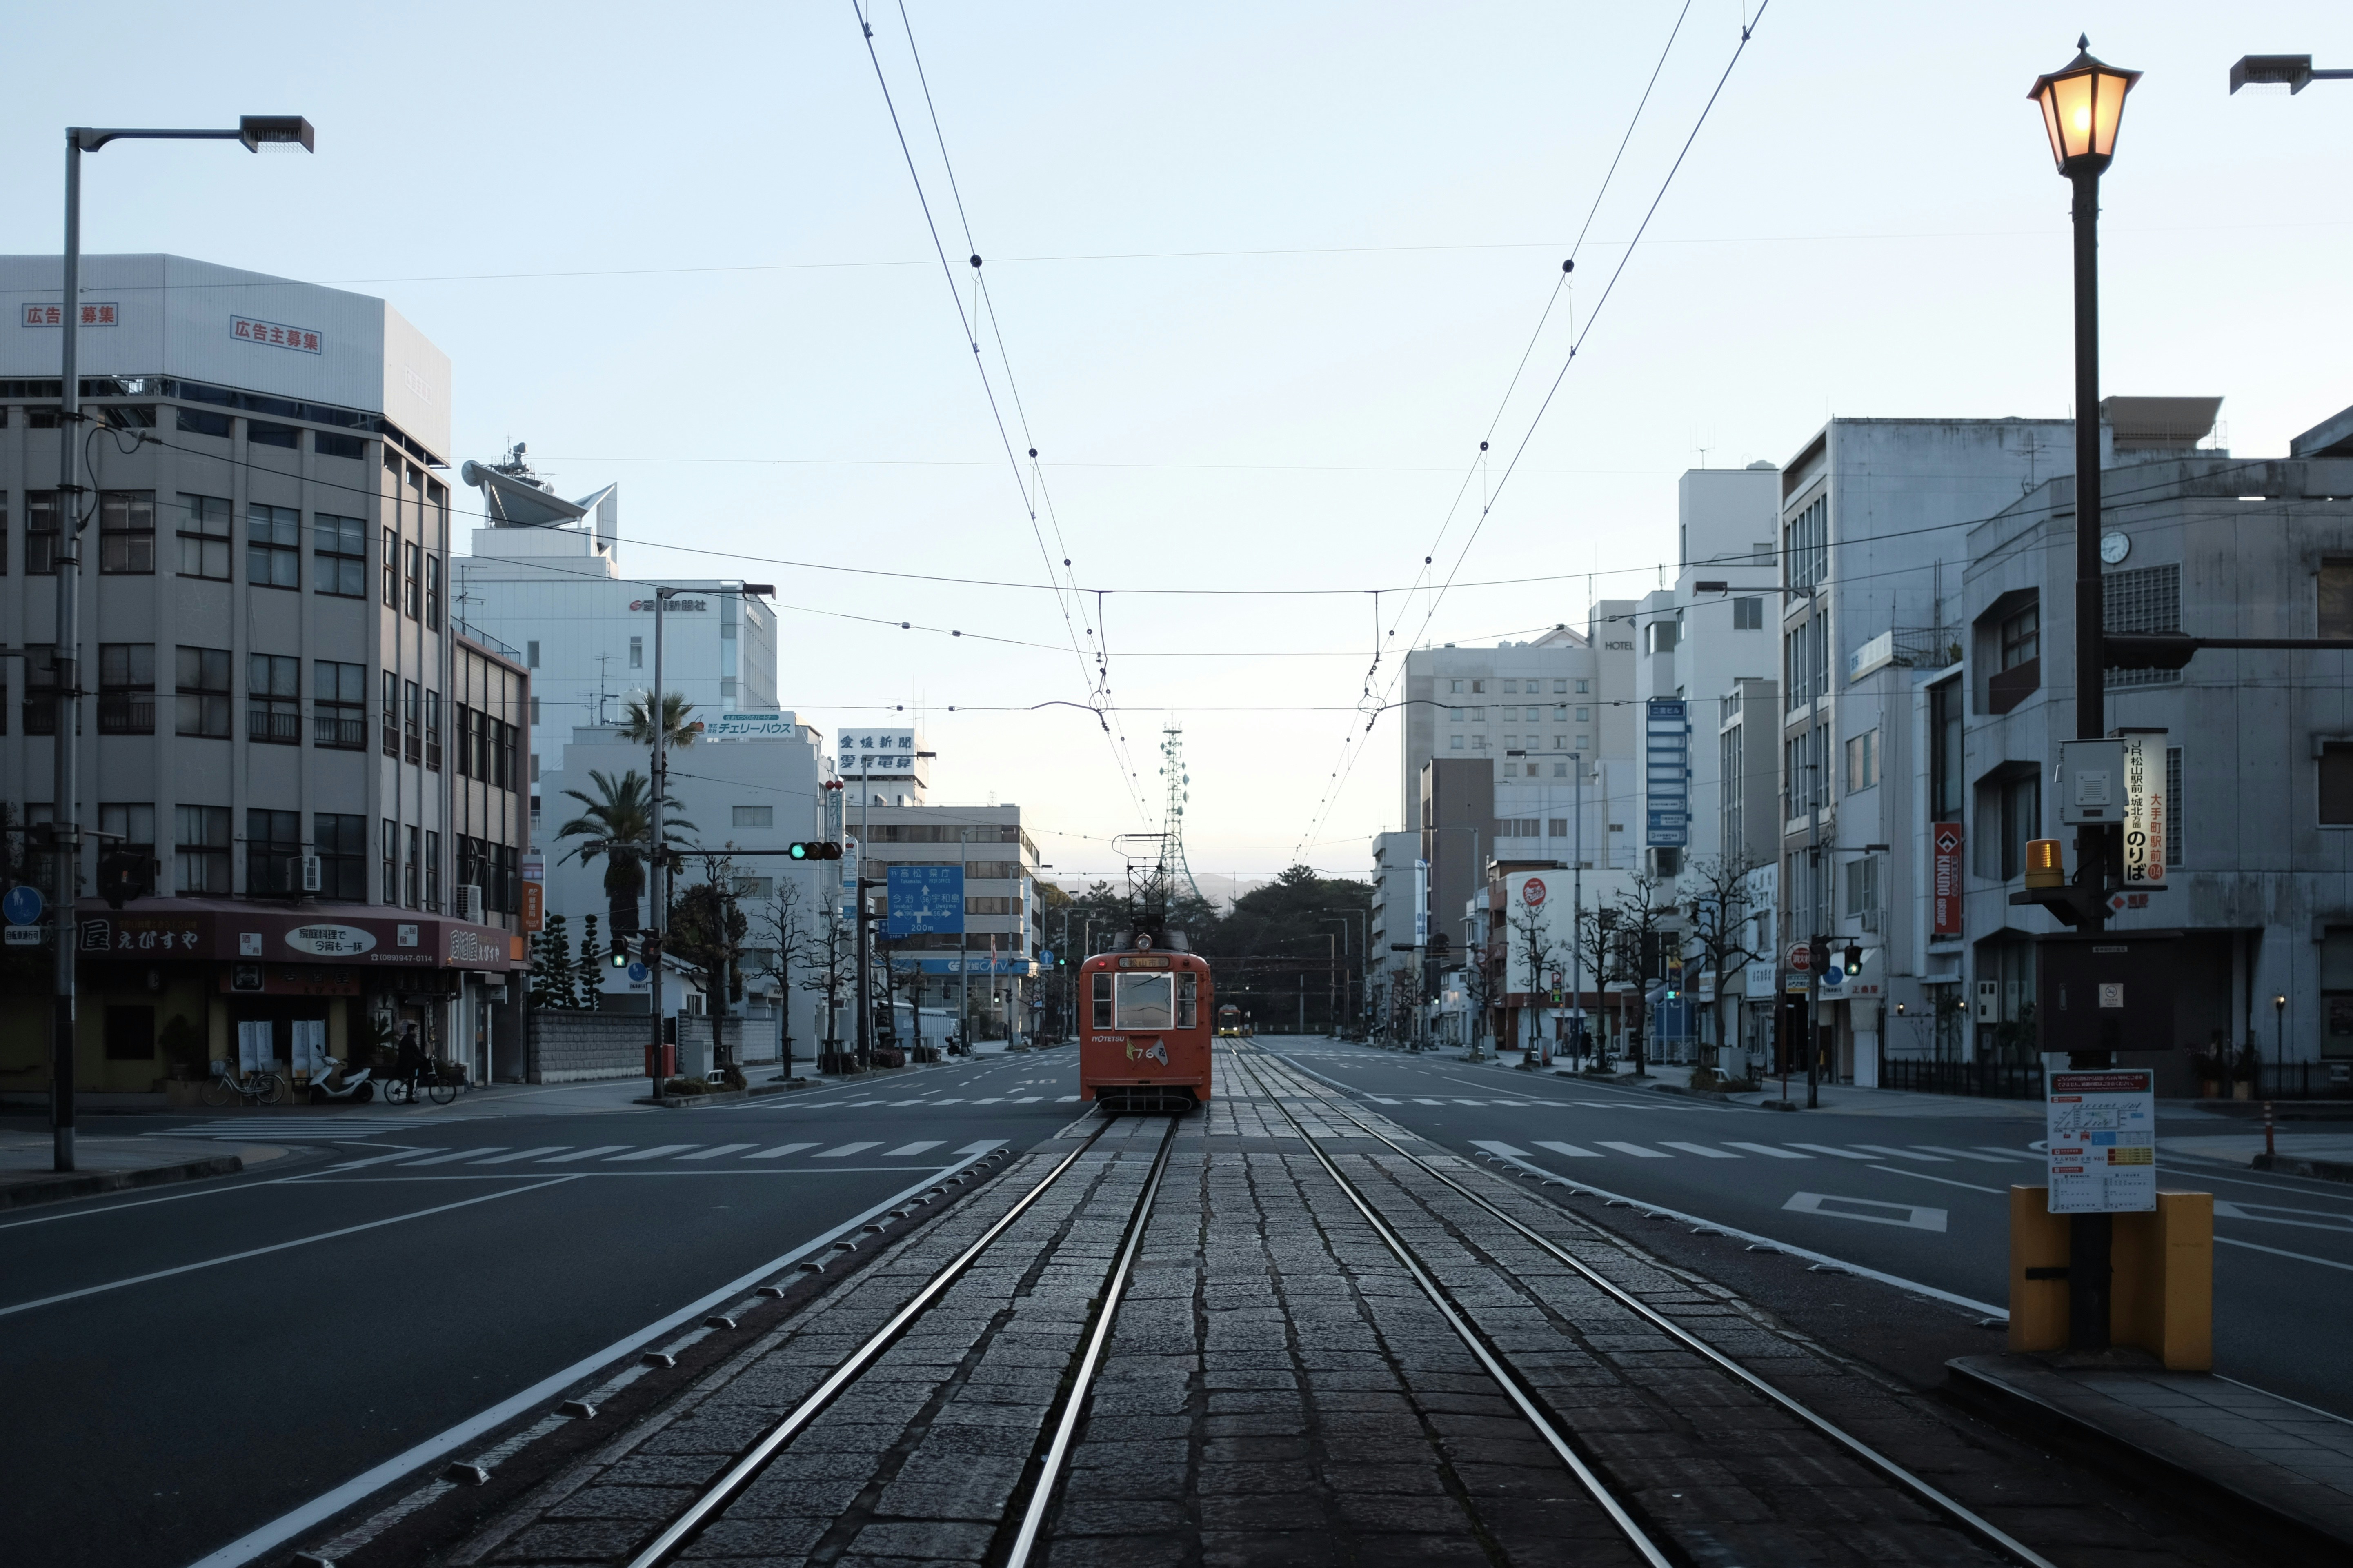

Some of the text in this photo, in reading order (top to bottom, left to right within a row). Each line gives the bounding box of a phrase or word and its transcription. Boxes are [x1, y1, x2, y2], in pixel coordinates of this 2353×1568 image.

[27, 306, 114, 324] 広告募集
[235, 321, 318, 350] 広告主募集
[1606, 642, 1634, 650] HOTEL
[718, 723, 790, 733] チェリーハウス
[840, 735, 911, 749] 愛媛新聞
[2151, 794, 2162, 862] 大手町駅前
[2127, 831, 2146, 881] のりば
[900, 868, 950, 878] 高松 県庁
[2149, 866, 2162, 877] 04
[1937, 855, 1950, 926] KIKUNO GROUP
[892, 894, 914, 903] 今治
[931, 894, 960, 903] 宇和島
[7, 931, 39, 940] 自転車通行可
[299, 928, 347, 939] 家庭料理で
[118, 930, 198, 950] えびすや
[450, 929, 477, 962] 居酒屋
[316, 941, 363, 952] 今宵も一杯
[380, 954, 433, 962] (089)947-0114
[479, 944, 500, 962] えびすや
